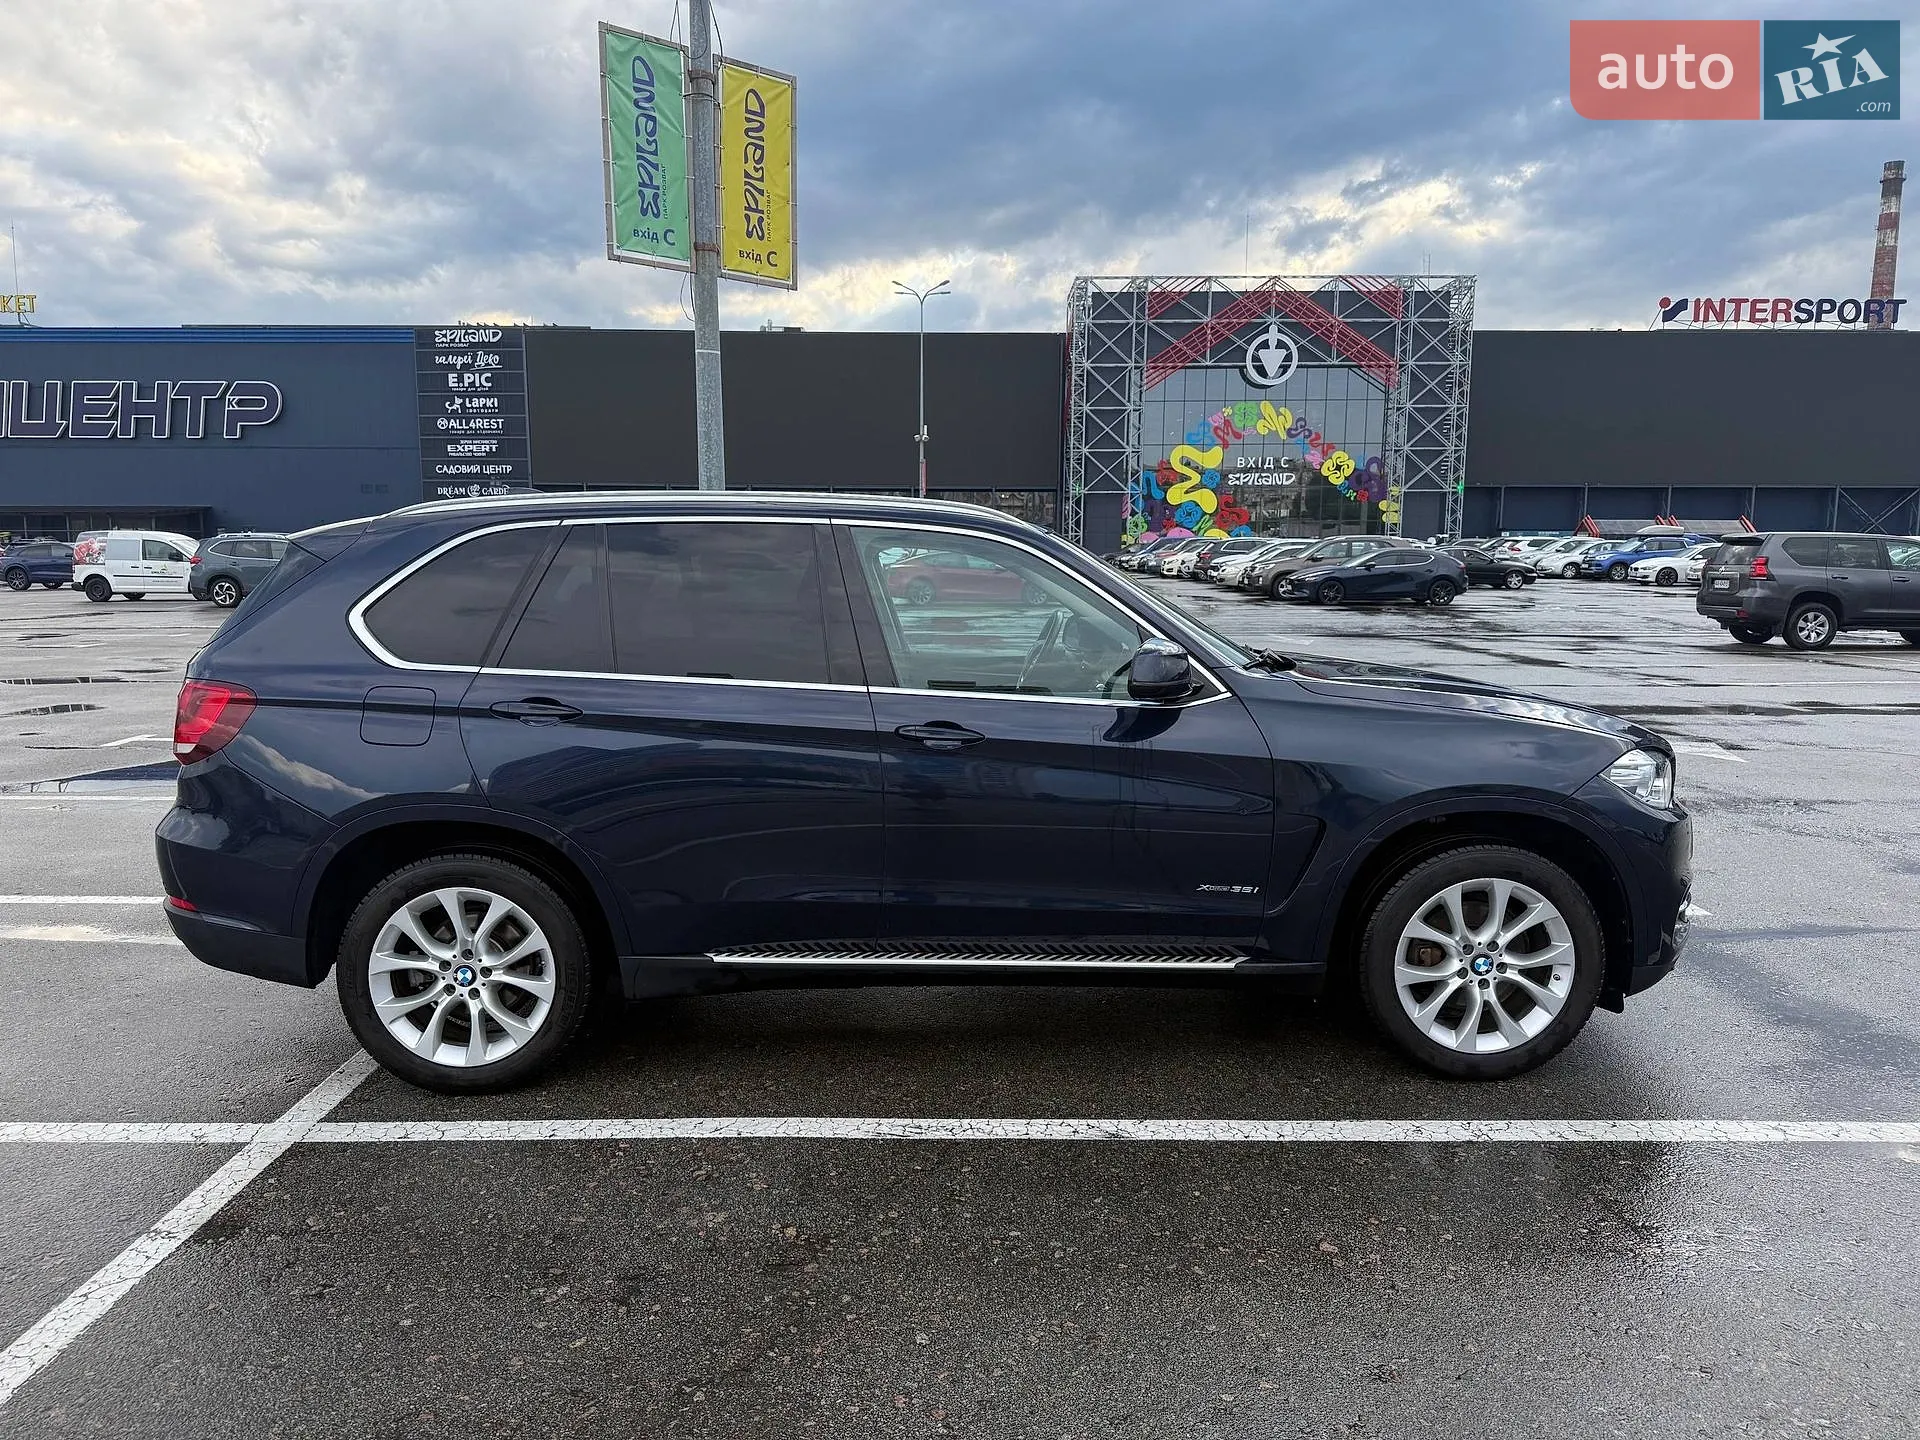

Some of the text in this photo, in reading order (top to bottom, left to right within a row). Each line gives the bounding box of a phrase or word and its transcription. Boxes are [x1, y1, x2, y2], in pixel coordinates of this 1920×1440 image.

[633, 227, 660, 244] вхід
[739, 249, 763, 265] вхід
[1693, 298, 1908, 324] INTERSPORT
[448, 373, 492, 388] E.PIC
[449, 418, 504, 429] ALL4REST
[447, 444, 499, 452] EXPERT
[435, 464, 513, 475] САДОВИЙ ЦЕНТР
[1237, 456, 1274, 470] ВХІД
